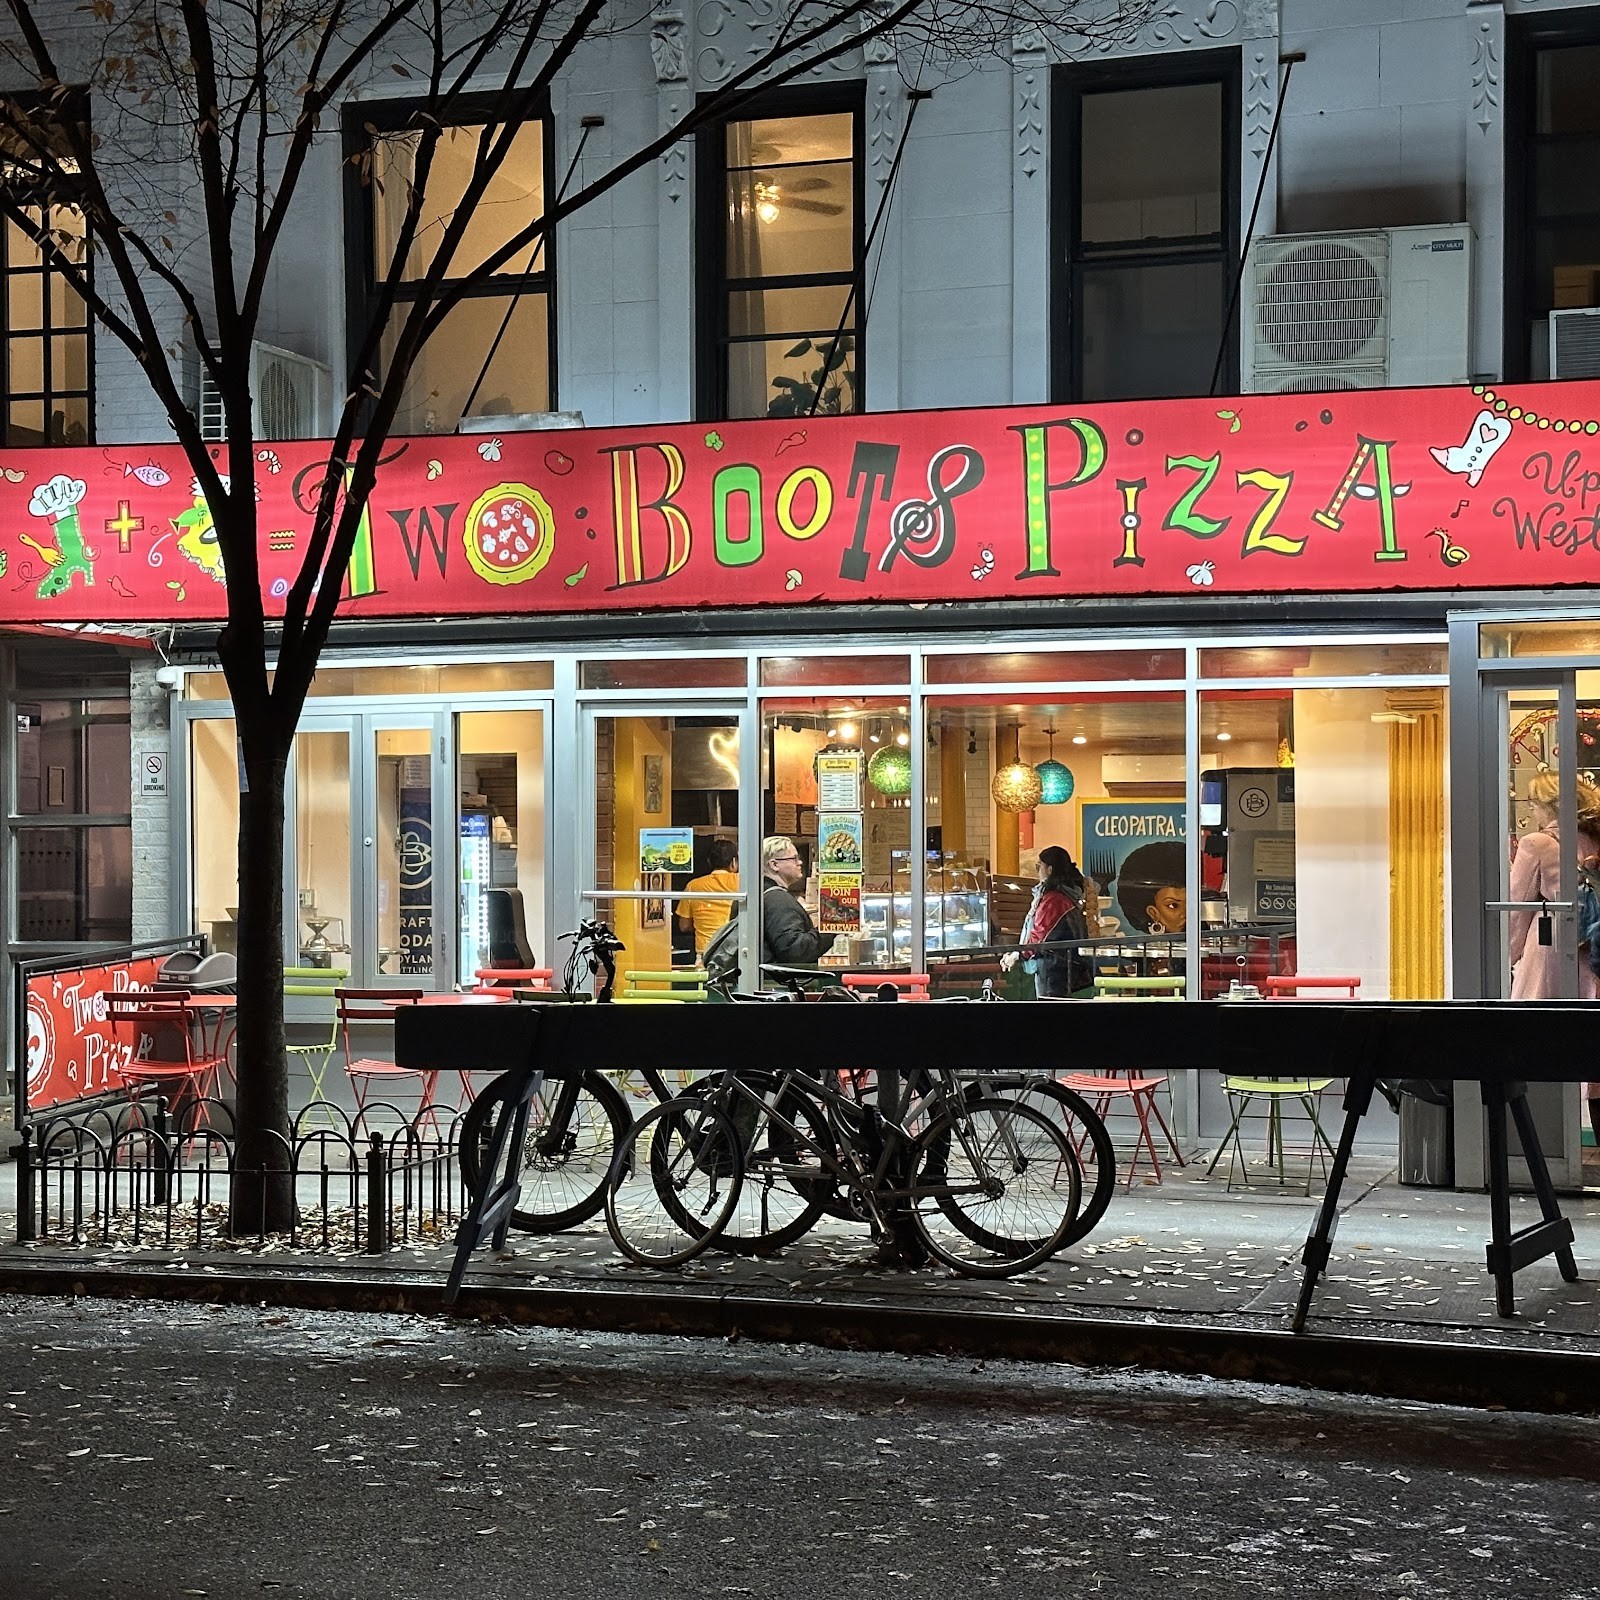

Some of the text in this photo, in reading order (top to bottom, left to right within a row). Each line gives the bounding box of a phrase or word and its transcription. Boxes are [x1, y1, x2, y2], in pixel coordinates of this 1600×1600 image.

[1094, 815, 1176, 837] CLEOPATRA
[830, 888, 851, 897] JOIN
[822, 923, 859, 932] KREWE
